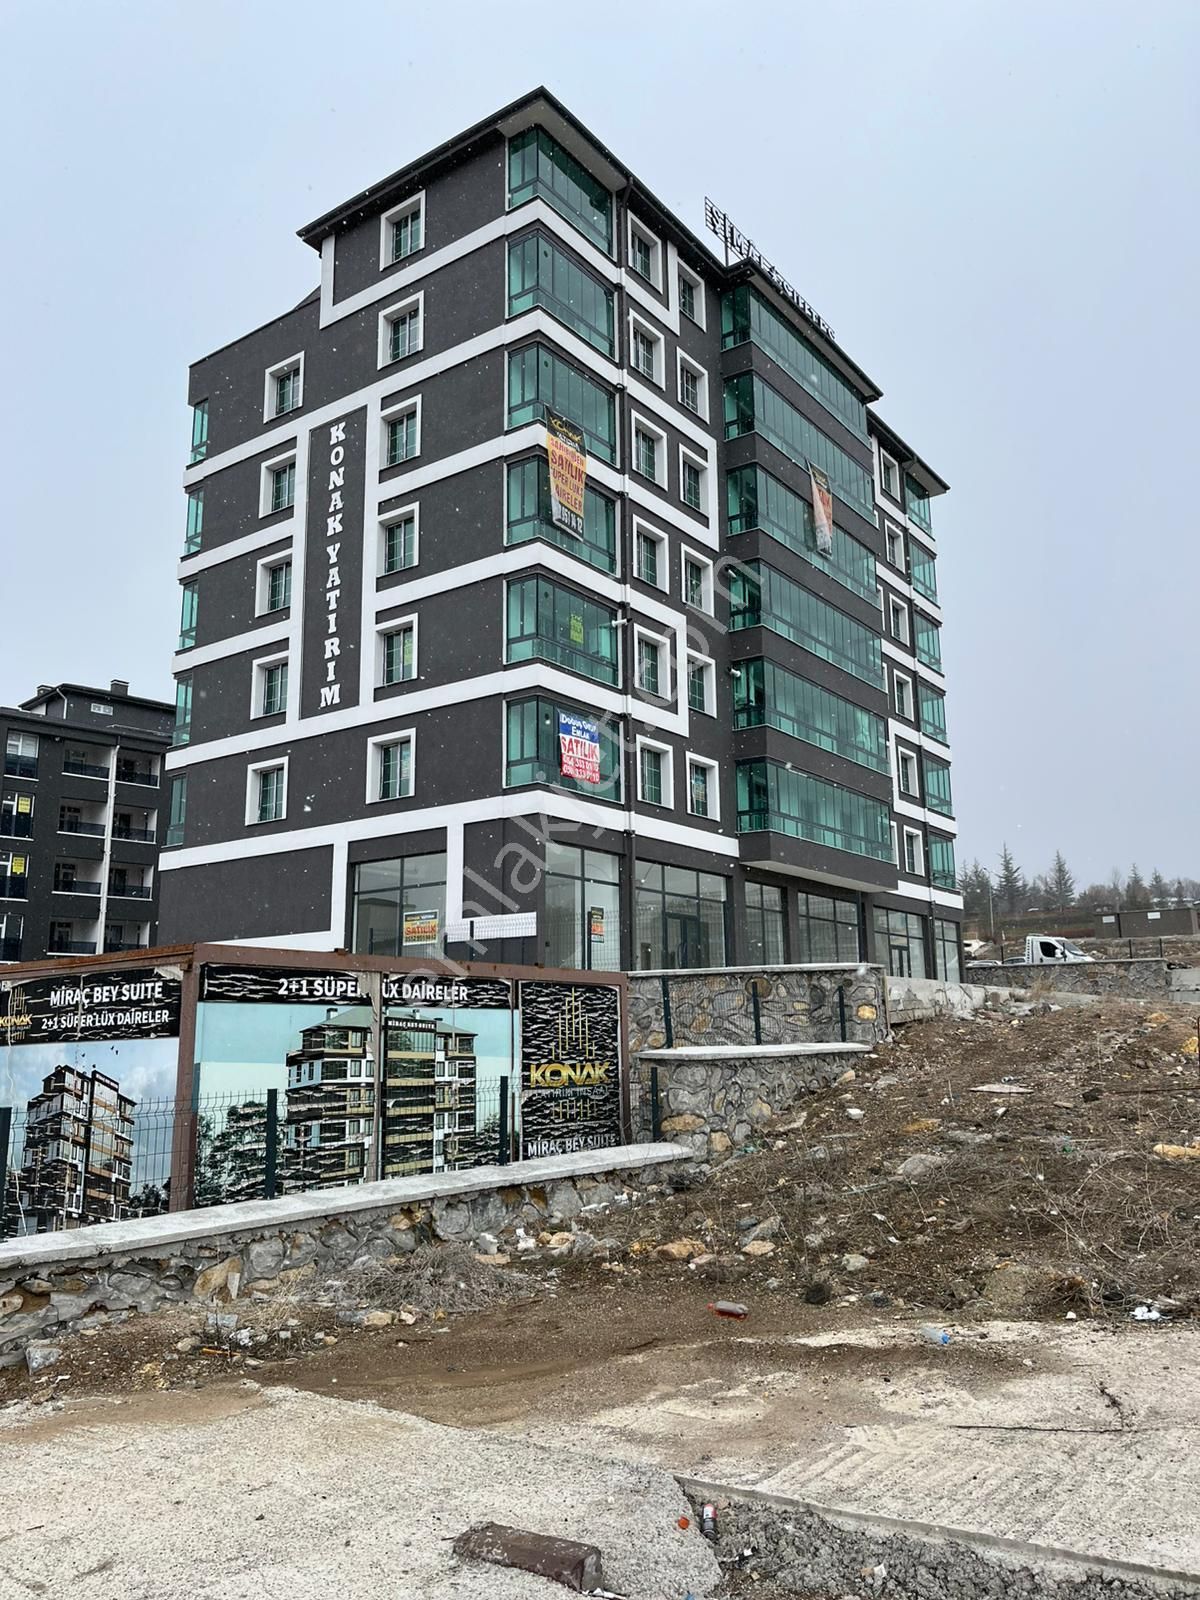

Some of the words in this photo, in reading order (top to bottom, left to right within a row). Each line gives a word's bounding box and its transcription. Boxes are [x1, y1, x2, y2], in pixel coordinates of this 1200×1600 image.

[326, 421, 346, 537] KONAK
[551, 449, 584, 484] SATILIK
[320, 542, 341, 708] YATIRIM
[561, 736, 598, 760] SATILIK
[50, 986, 91, 1009] MİRAÇ
[93, 985, 119, 1003] BEY
[121, 981, 163, 1001] SUITE
[278, 978, 309, 996] 2+1
[381, 979, 399, 998] ÜX
[402, 980, 468, 1001] DAİRELER
[41, 1016, 59, 1030] 2+1
[60, 1012, 93, 1029] SÜPER
[95, 1010, 115, 1027] LÜX
[117, 1008, 169, 1025] DAİRELER
[530, 1062, 610, 1088] KONAK
[565, 1136, 585, 1152] BEY
